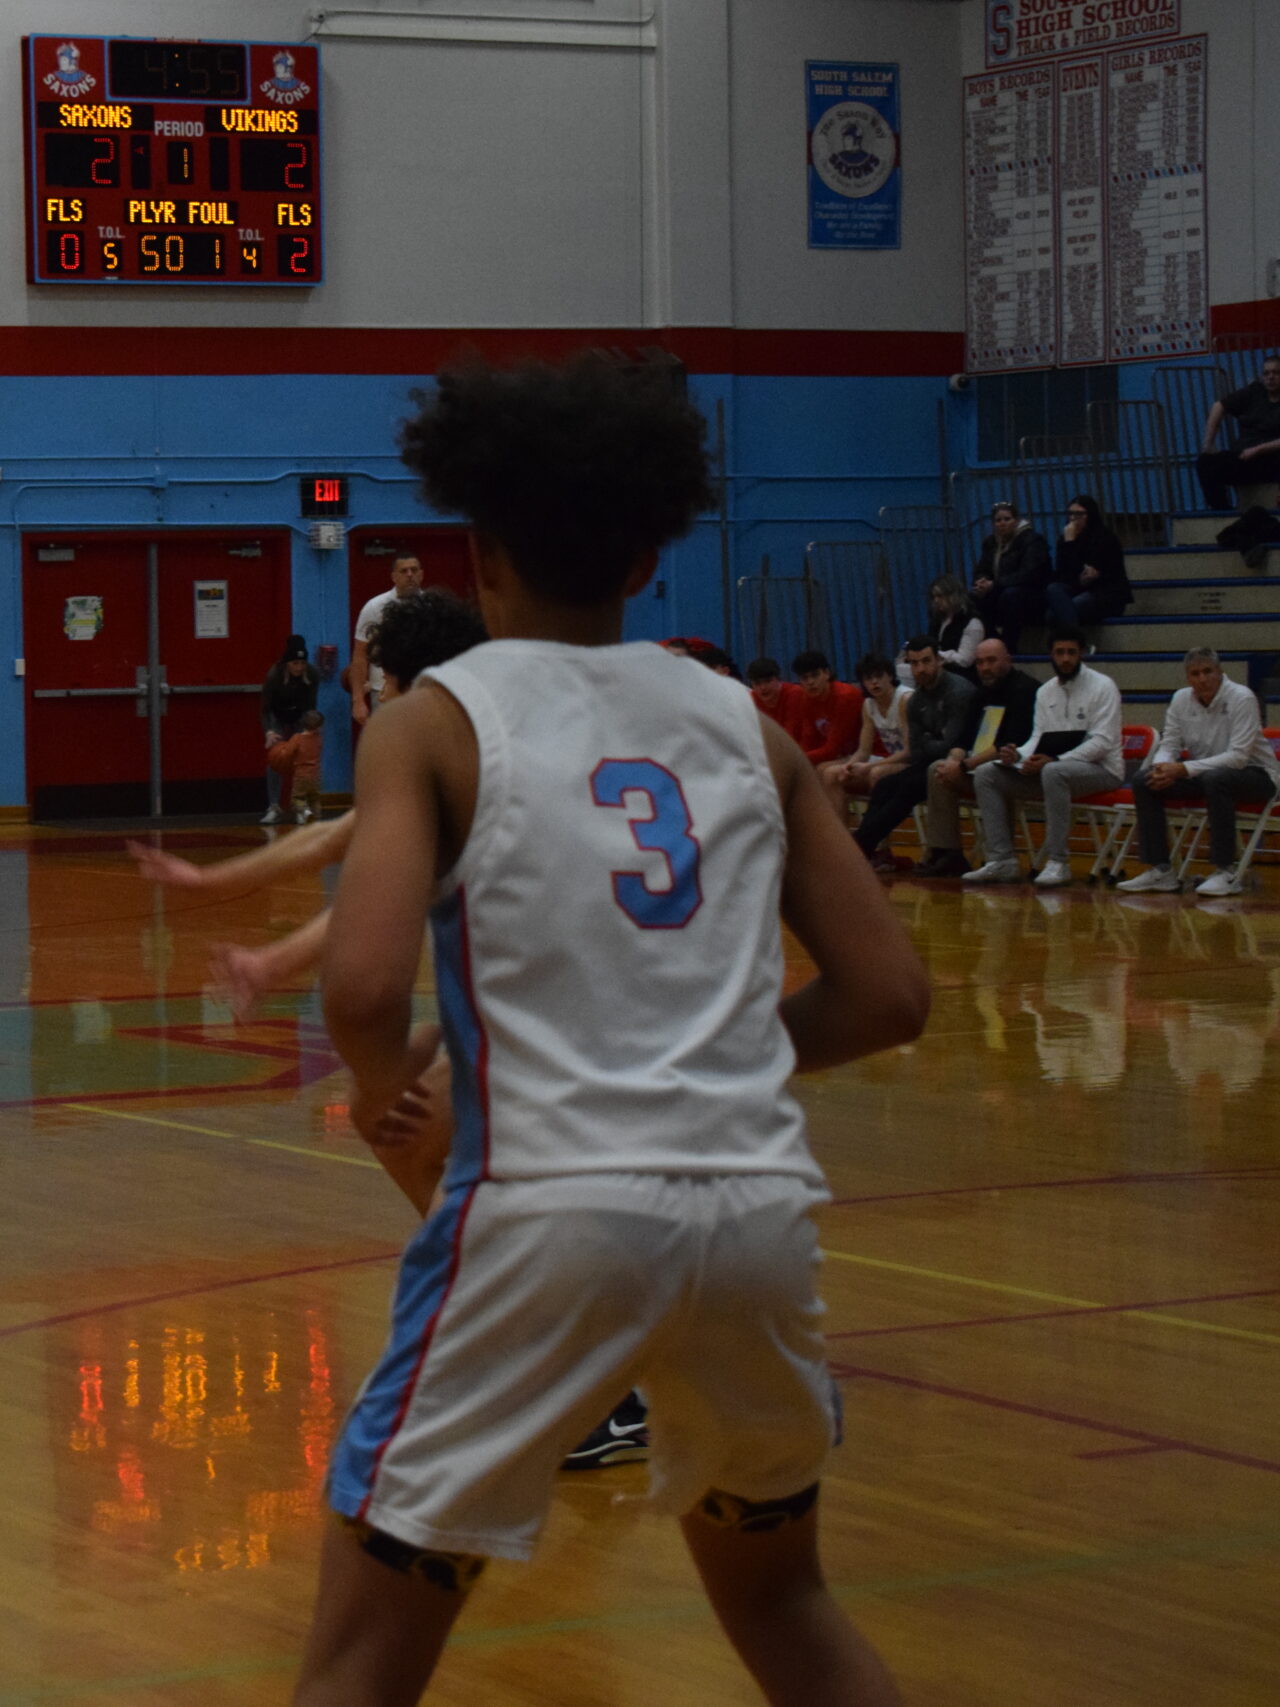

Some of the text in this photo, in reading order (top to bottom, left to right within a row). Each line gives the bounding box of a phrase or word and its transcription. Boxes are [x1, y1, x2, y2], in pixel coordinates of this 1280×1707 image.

[1016, 10, 1073, 38] HIGH
[1016, 12, 1176, 56] TRACK & FIELD RECORDS
[1112, 41, 1202, 71] GIRLS RECORDS
[43, 72, 97, 98] SAXONS
[811, 69, 894, 83] SOUTH SALEM
[999, 69, 1050, 91] RECORDS
[259, 79, 311, 105] SAXONS
[815, 83, 890, 97] HIGH SCHOOL
[58, 104, 133, 129] SAXONS
[153, 120, 205, 137] PERIOD
[221, 108, 299, 134] VIKINGS
[90, 137, 115, 185] 2
[182, 147, 190, 179] 1
[283, 142, 307, 189] 2
[828, 153, 880, 179] SAXONS
[46, 198, 84, 223] FLS
[128, 200, 235, 225] PLYR FOUL
[277, 203, 313, 226] FLS
[59, 233, 80, 271] 0
[103, 242, 119, 269] 5
[140, 235, 185, 272] 50
[242, 246, 258, 269] 4
[289, 237, 309, 273] 2
[315, 479, 340, 502] EXIT
[588, 757, 704, 930] 3
